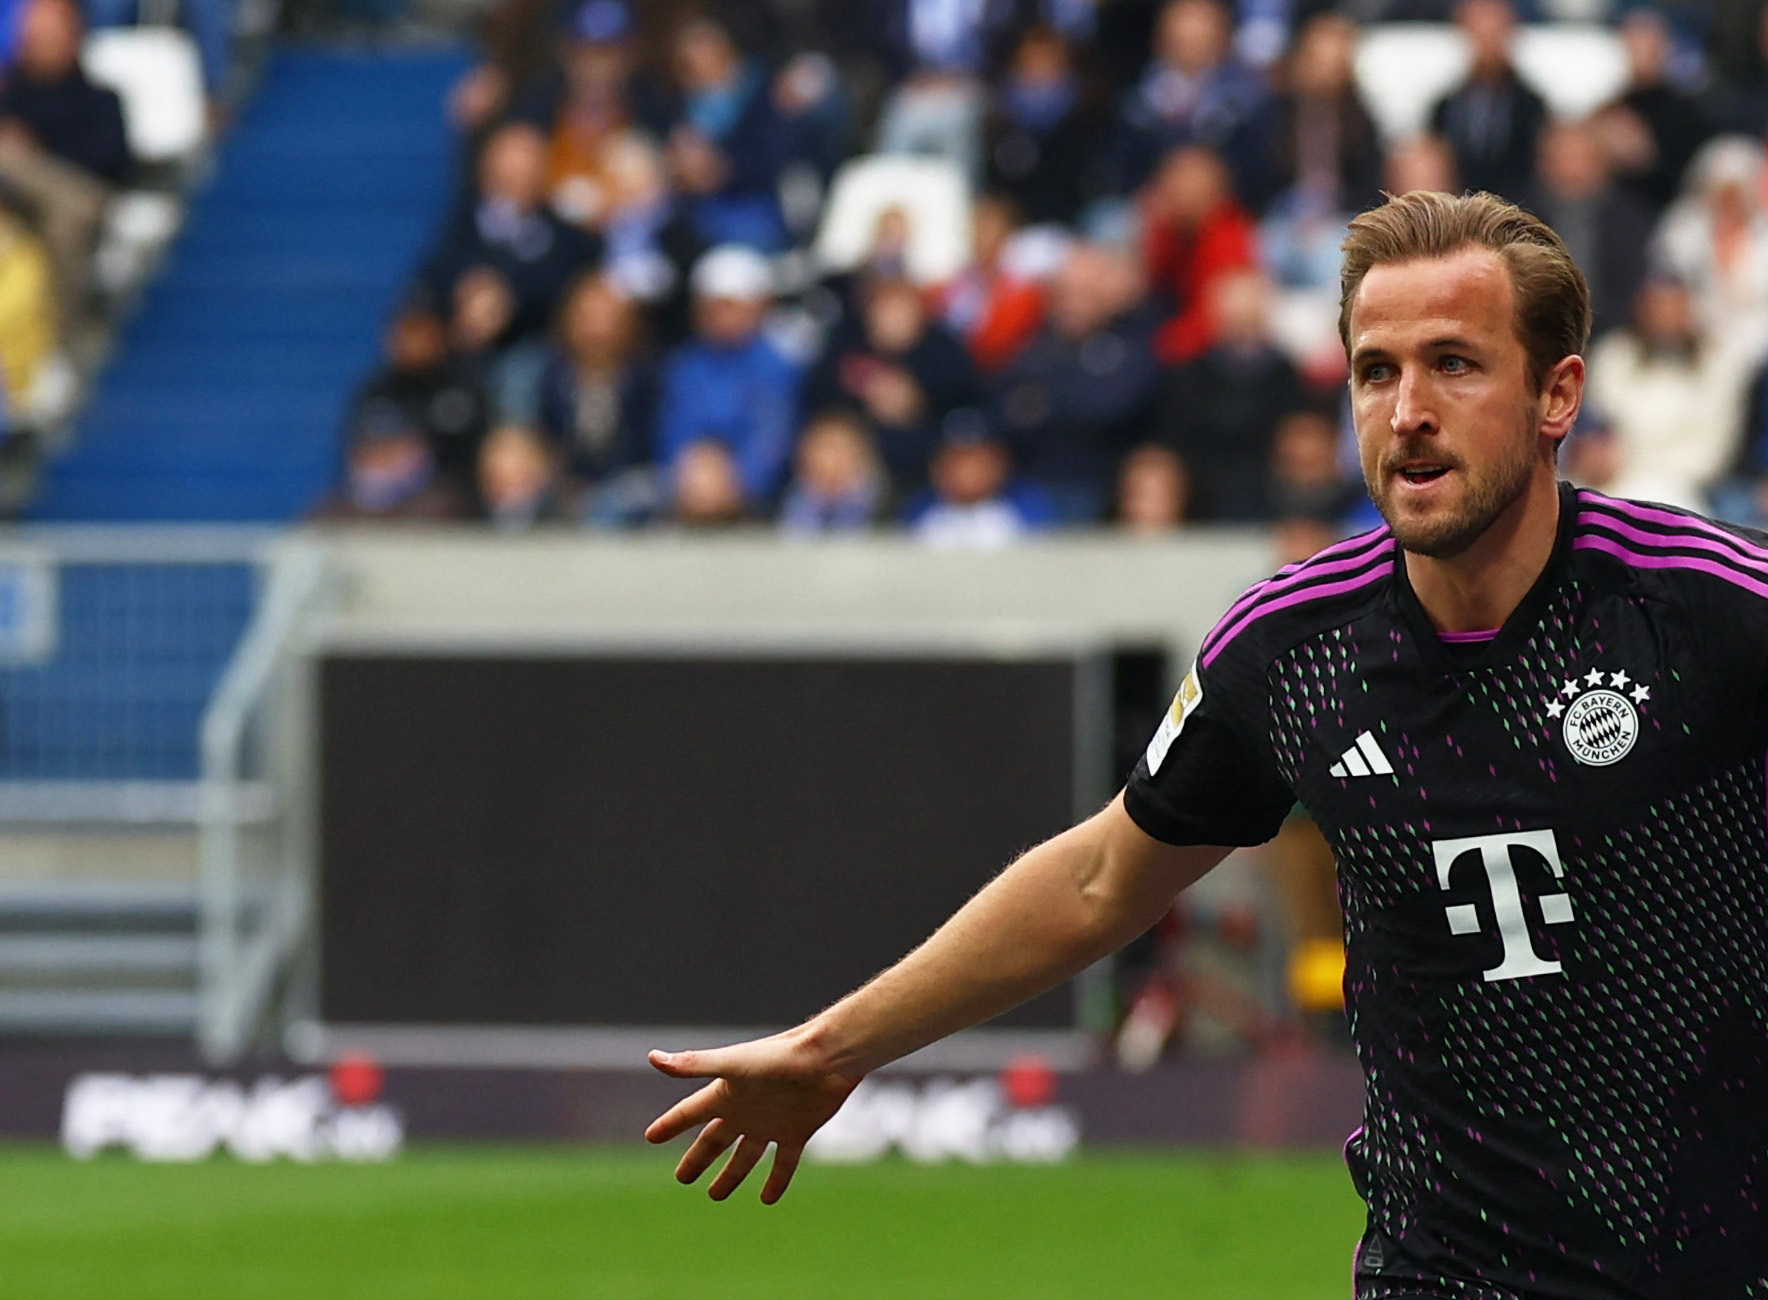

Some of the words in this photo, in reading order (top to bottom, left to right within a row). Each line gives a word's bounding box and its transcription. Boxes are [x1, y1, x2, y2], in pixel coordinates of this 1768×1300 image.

[1569, 711, 1583, 728] FC
[1581, 695, 1630, 719] BAYERN
[1572, 730, 1632, 761] MÜNCHEN
[1432, 828, 1575, 983] T
